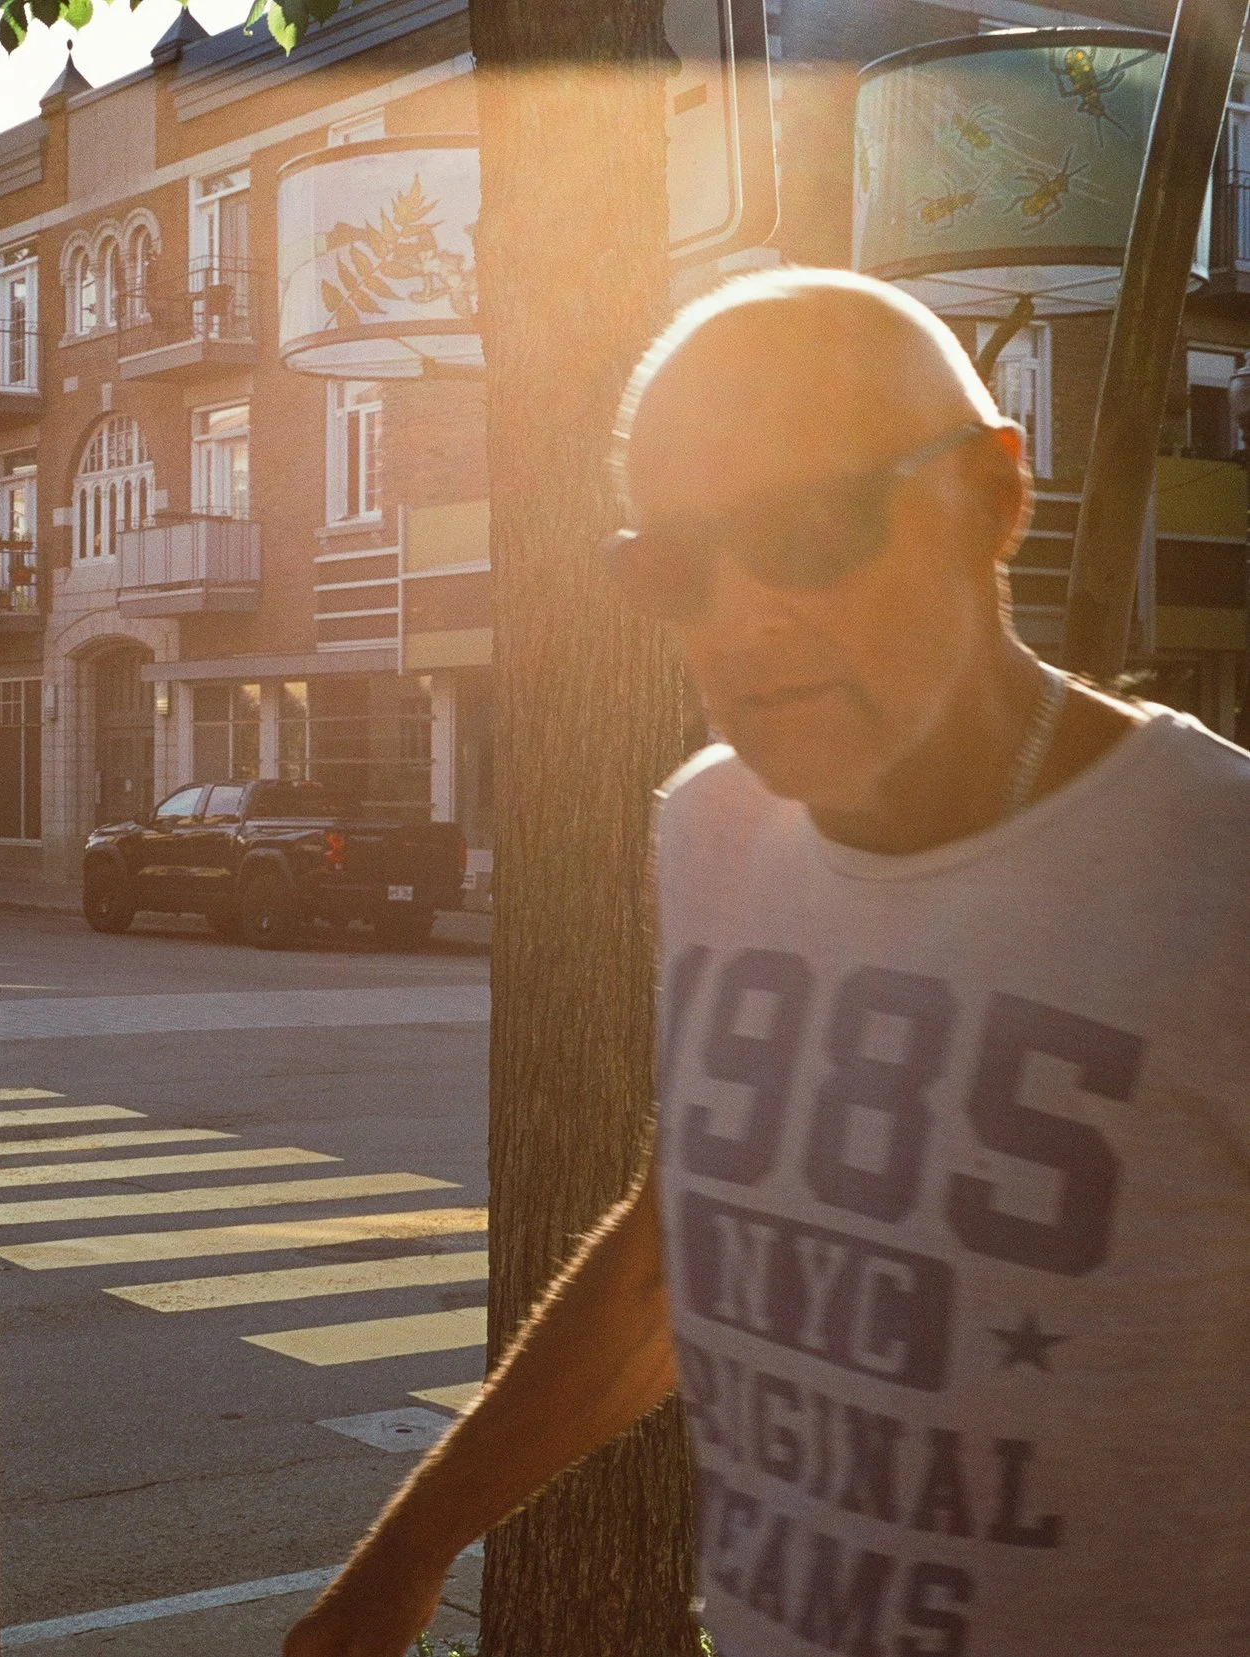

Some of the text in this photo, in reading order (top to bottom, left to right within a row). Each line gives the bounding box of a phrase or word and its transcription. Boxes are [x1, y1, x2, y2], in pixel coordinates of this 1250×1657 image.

[711, 1213, 916, 1374] NYC
[675, 1336, 1063, 1549] RIGINAL
[696, 1468, 976, 1657] EAMS
